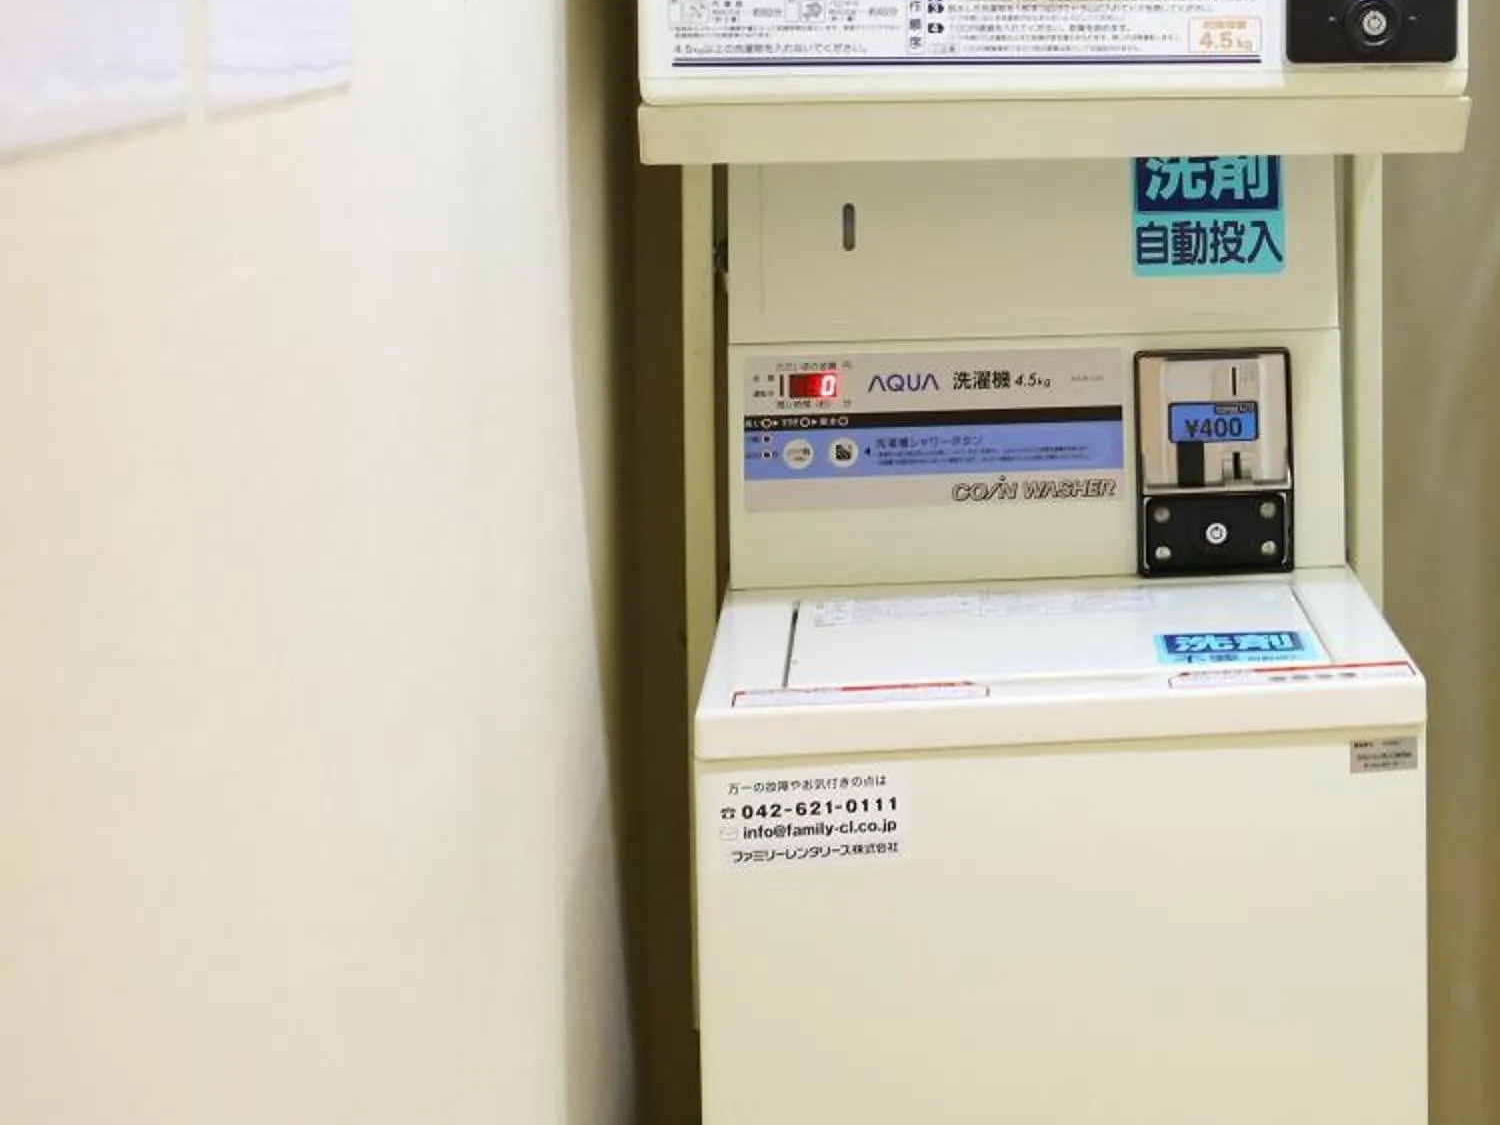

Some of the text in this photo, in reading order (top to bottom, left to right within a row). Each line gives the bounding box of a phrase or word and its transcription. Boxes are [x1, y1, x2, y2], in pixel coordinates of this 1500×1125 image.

[1135, 219, 1284, 266] 自動投入
[820, 374, 836, 396] 0
[867, 373, 940, 393] AQUA
[952, 369, 1052, 391] 洗濯機 4.5kg
[1184, 416, 1243, 438] ¥400
[1023, 477, 1117, 501] WASHER
[1175, 632, 1295, 652] 洗剤
[728, 774, 888, 796] 万一の故障やお気付きの点は
[741, 796, 898, 820] 042-621-0111
[742, 819, 898, 840] info@family-cl.co.jp
[731, 841, 899, 864] ファミリーレンタリース株式会社
